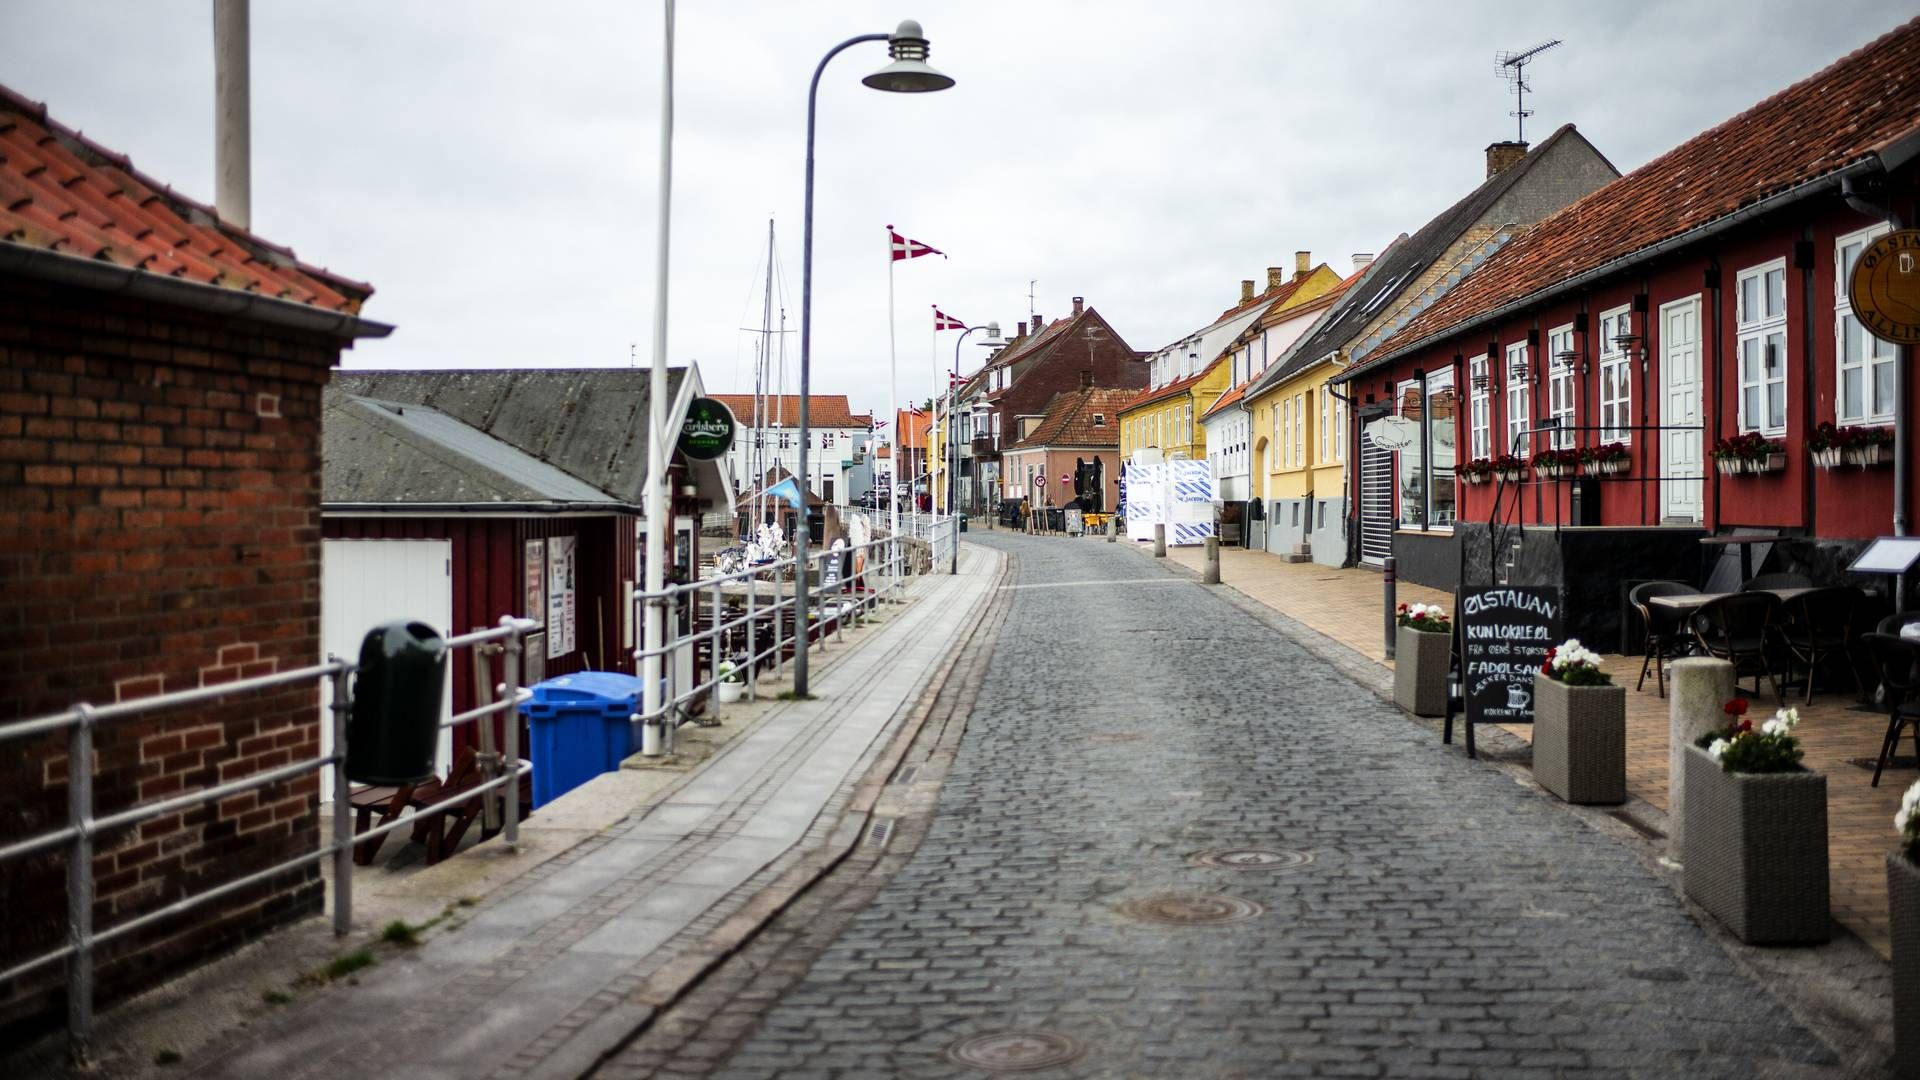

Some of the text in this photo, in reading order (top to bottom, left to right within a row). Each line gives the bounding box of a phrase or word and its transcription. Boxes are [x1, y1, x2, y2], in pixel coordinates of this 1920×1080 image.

[1467, 623, 1552, 640] KUN LOKALE ØL
